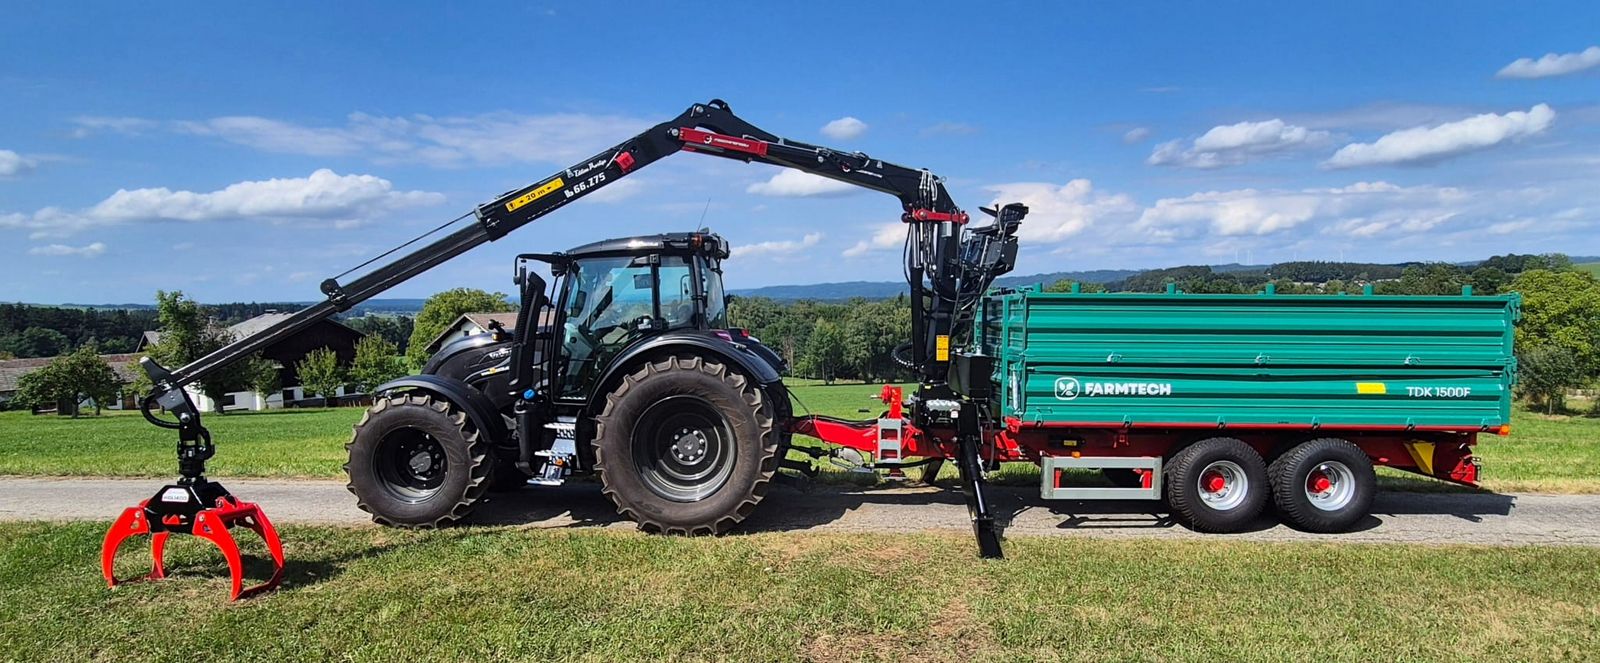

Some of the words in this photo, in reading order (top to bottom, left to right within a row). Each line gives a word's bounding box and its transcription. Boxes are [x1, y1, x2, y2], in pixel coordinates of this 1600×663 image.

[526, 192, 536, 201] 20
[1085, 382, 1172, 397] FARMTECH
[1405, 386, 1433, 398] TDK
[1434, 386, 1472, 398] 1500F
